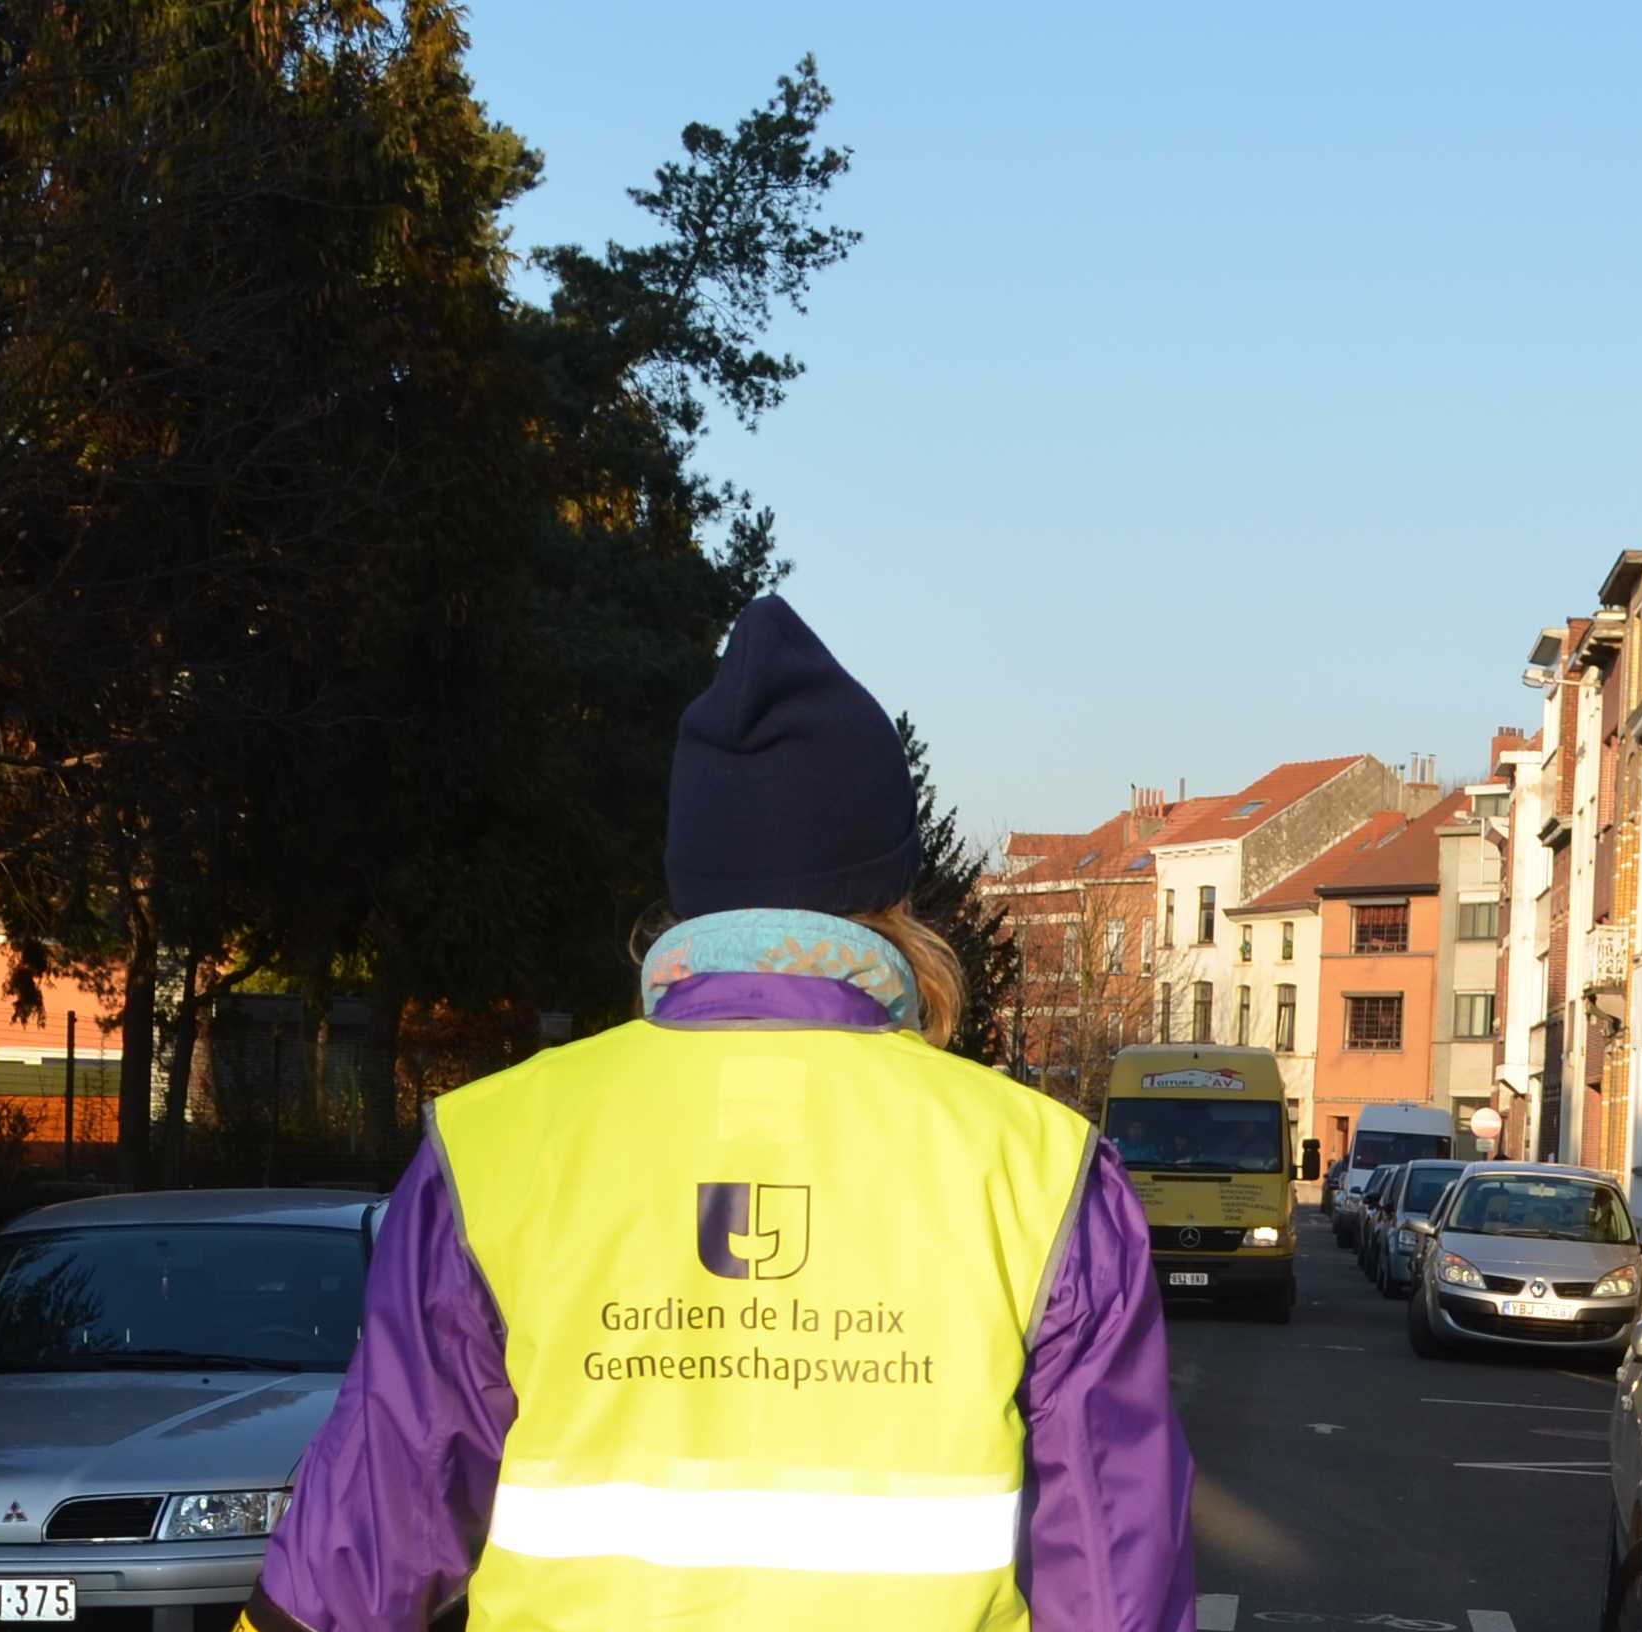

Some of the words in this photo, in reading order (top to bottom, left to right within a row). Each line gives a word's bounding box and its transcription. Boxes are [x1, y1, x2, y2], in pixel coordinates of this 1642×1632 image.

[601, 1298, 725, 1332] Gardien
[739, 1297, 777, 1331] de
[791, 1299, 820, 1333] la
[833, 1301, 905, 1341] paix
[583, 1347, 934, 1390] Gemeenschapswacht
